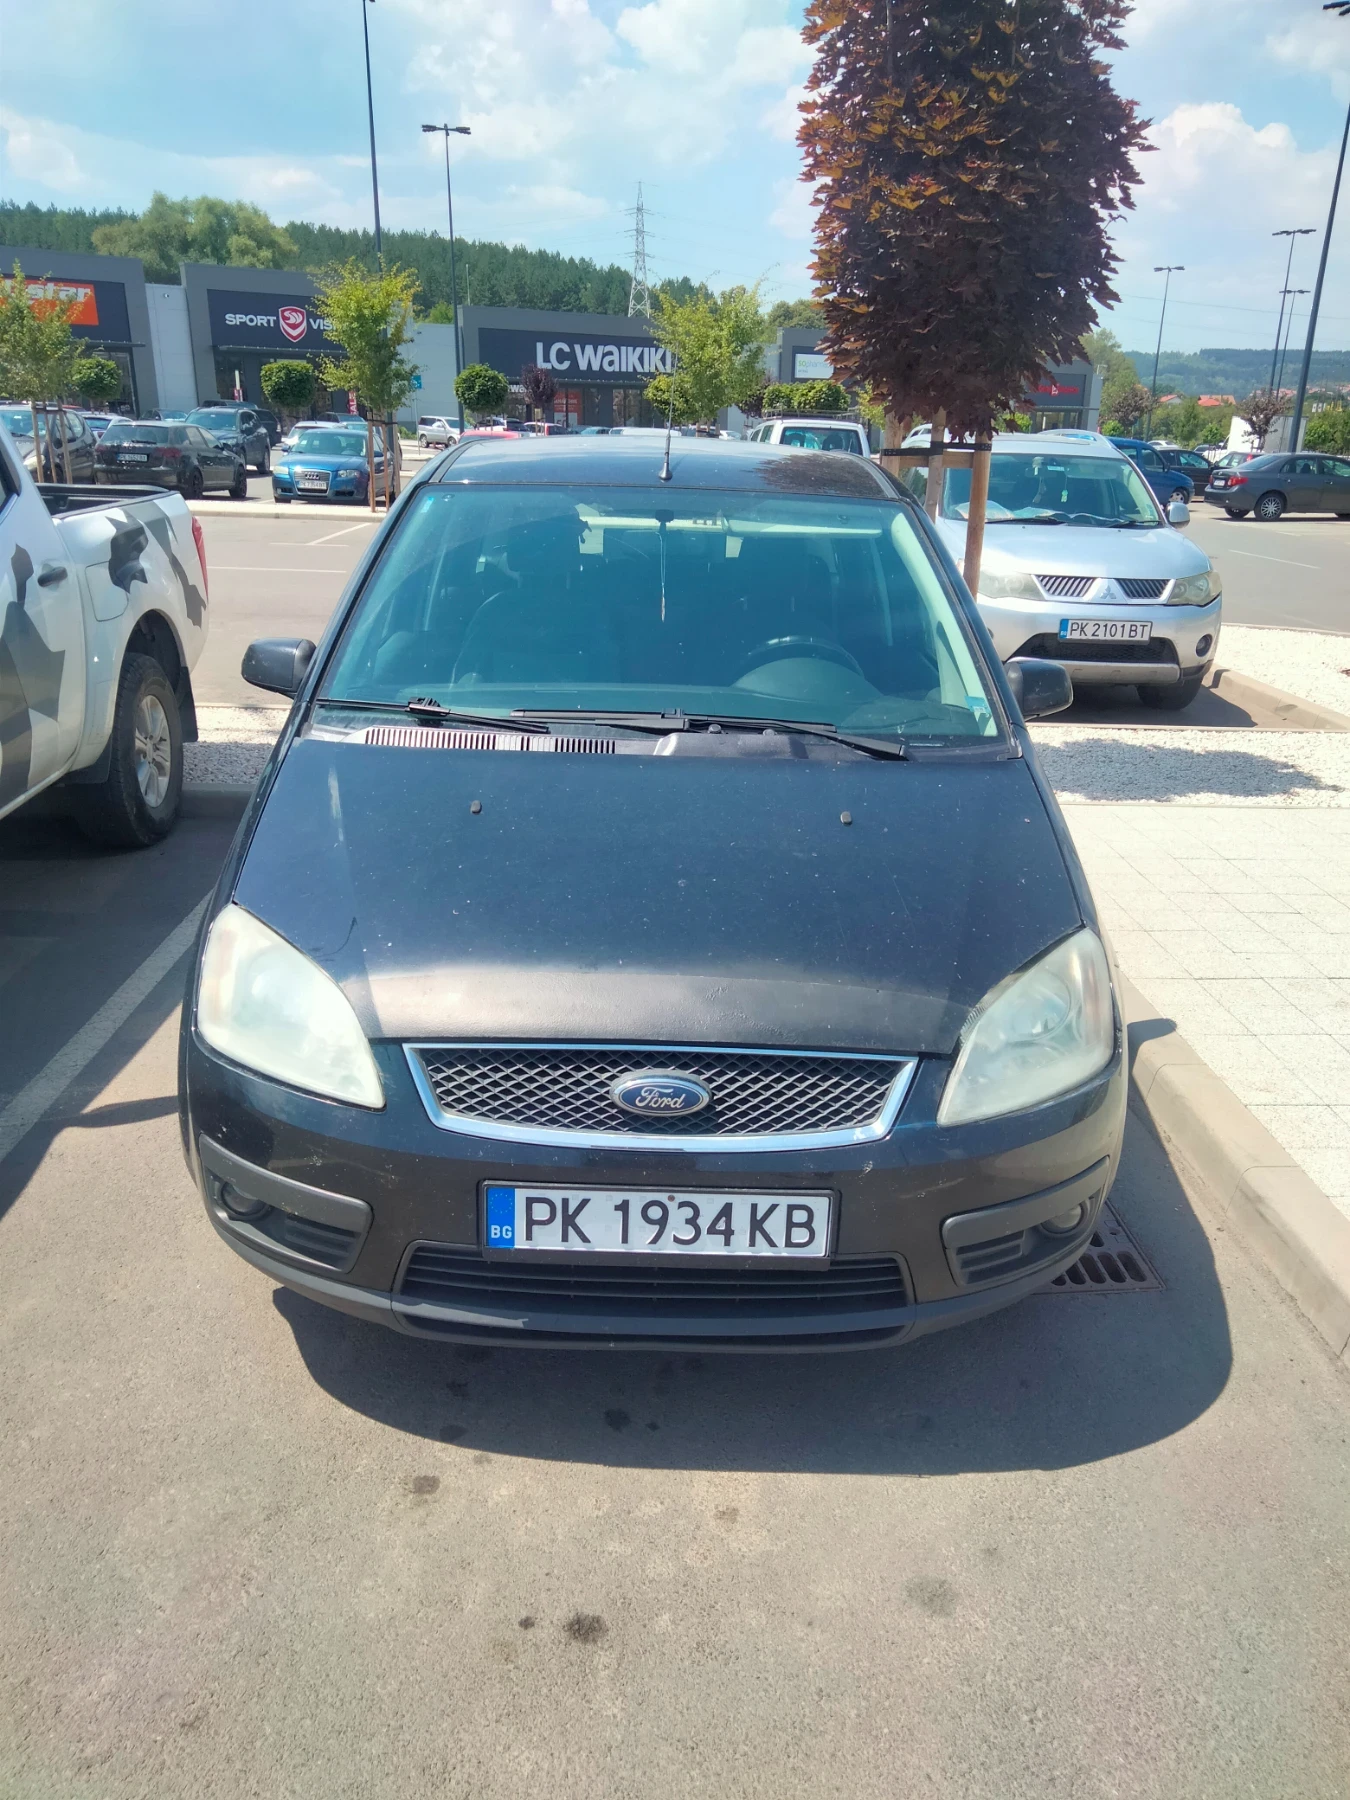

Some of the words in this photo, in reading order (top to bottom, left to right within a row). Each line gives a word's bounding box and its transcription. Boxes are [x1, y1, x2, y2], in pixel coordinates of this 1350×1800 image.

[224, 313, 277, 327] SPORT
[536, 341, 571, 371] LC
[1070, 621, 1089, 637] PK
[635, 1086, 686, 1109] Ford
[490, 1225, 512, 1239] BG
[524, 1196, 591, 1245] PK
